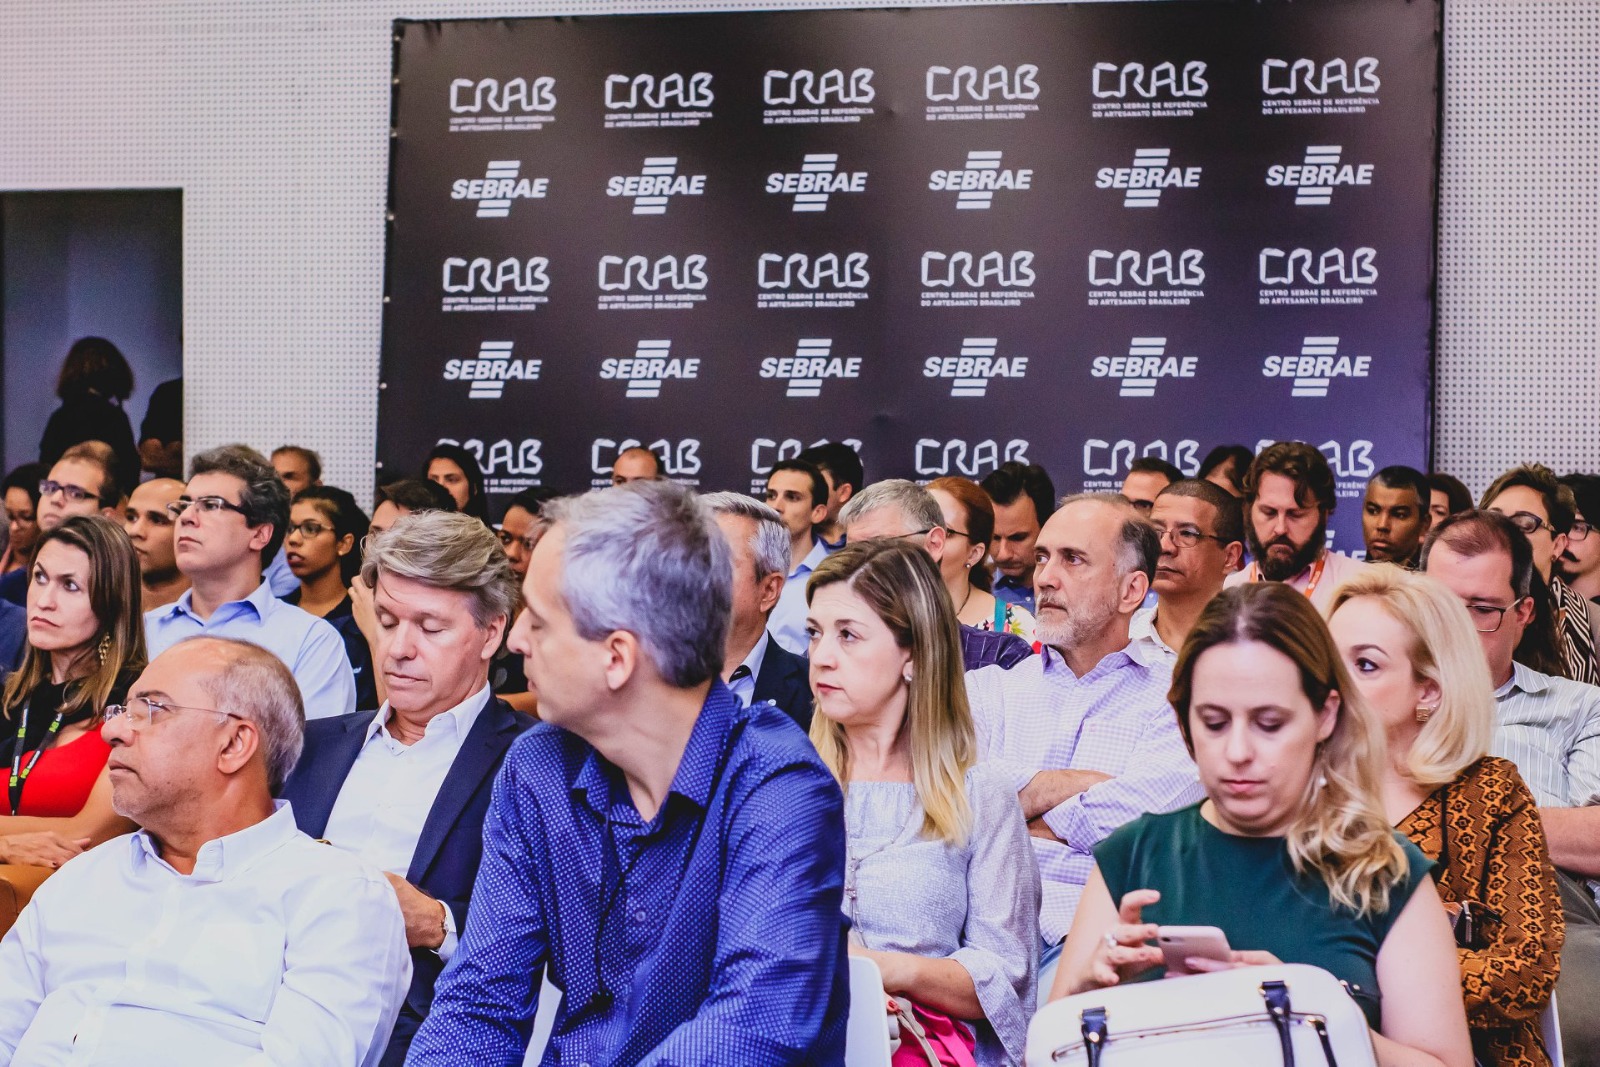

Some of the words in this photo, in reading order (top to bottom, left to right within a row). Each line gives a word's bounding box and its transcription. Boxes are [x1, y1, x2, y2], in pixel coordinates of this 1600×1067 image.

[763, 67, 876, 106] CRAB
[926, 63, 1041, 102] CRAB
[1092, 60, 1209, 99] CRAB
[1261, 56, 1381, 96] CRAB
[449, 76, 557, 114] CRAB
[604, 71, 715, 110] CRAB
[1323, 106, 1365, 114] BRASILEIRO
[606, 174, 707, 197] SEBRAE
[765, 171, 869, 194] SEBRAE
[928, 169, 1034, 191] SEBRAE
[1095, 166, 1203, 189] SEBRAE
[1265, 163, 1375, 187] SEBRAE
[450, 177, 550, 200] SEBRAE
[442, 256, 551, 294] CRAB
[598, 253, 709, 291] CRAB
[757, 251, 870, 290] CRAB
[921, 250, 1036, 288] CRAB
[1088, 248, 1206, 287] CRAB
[1259, 246, 1379, 285] CRAB
[1291, 289, 1319, 297] SEBRAE
[442, 358, 543, 381] SEBRAE
[599, 357, 701, 380] SEBRAE
[759, 357, 863, 379] SEBRAE
[922, 356, 1029, 378] SEBRAE
[1090, 355, 1199, 378] SEBRAE
[1262, 355, 1372, 378] SEBRAE
[1083, 480, 1112, 488] CENTRO
